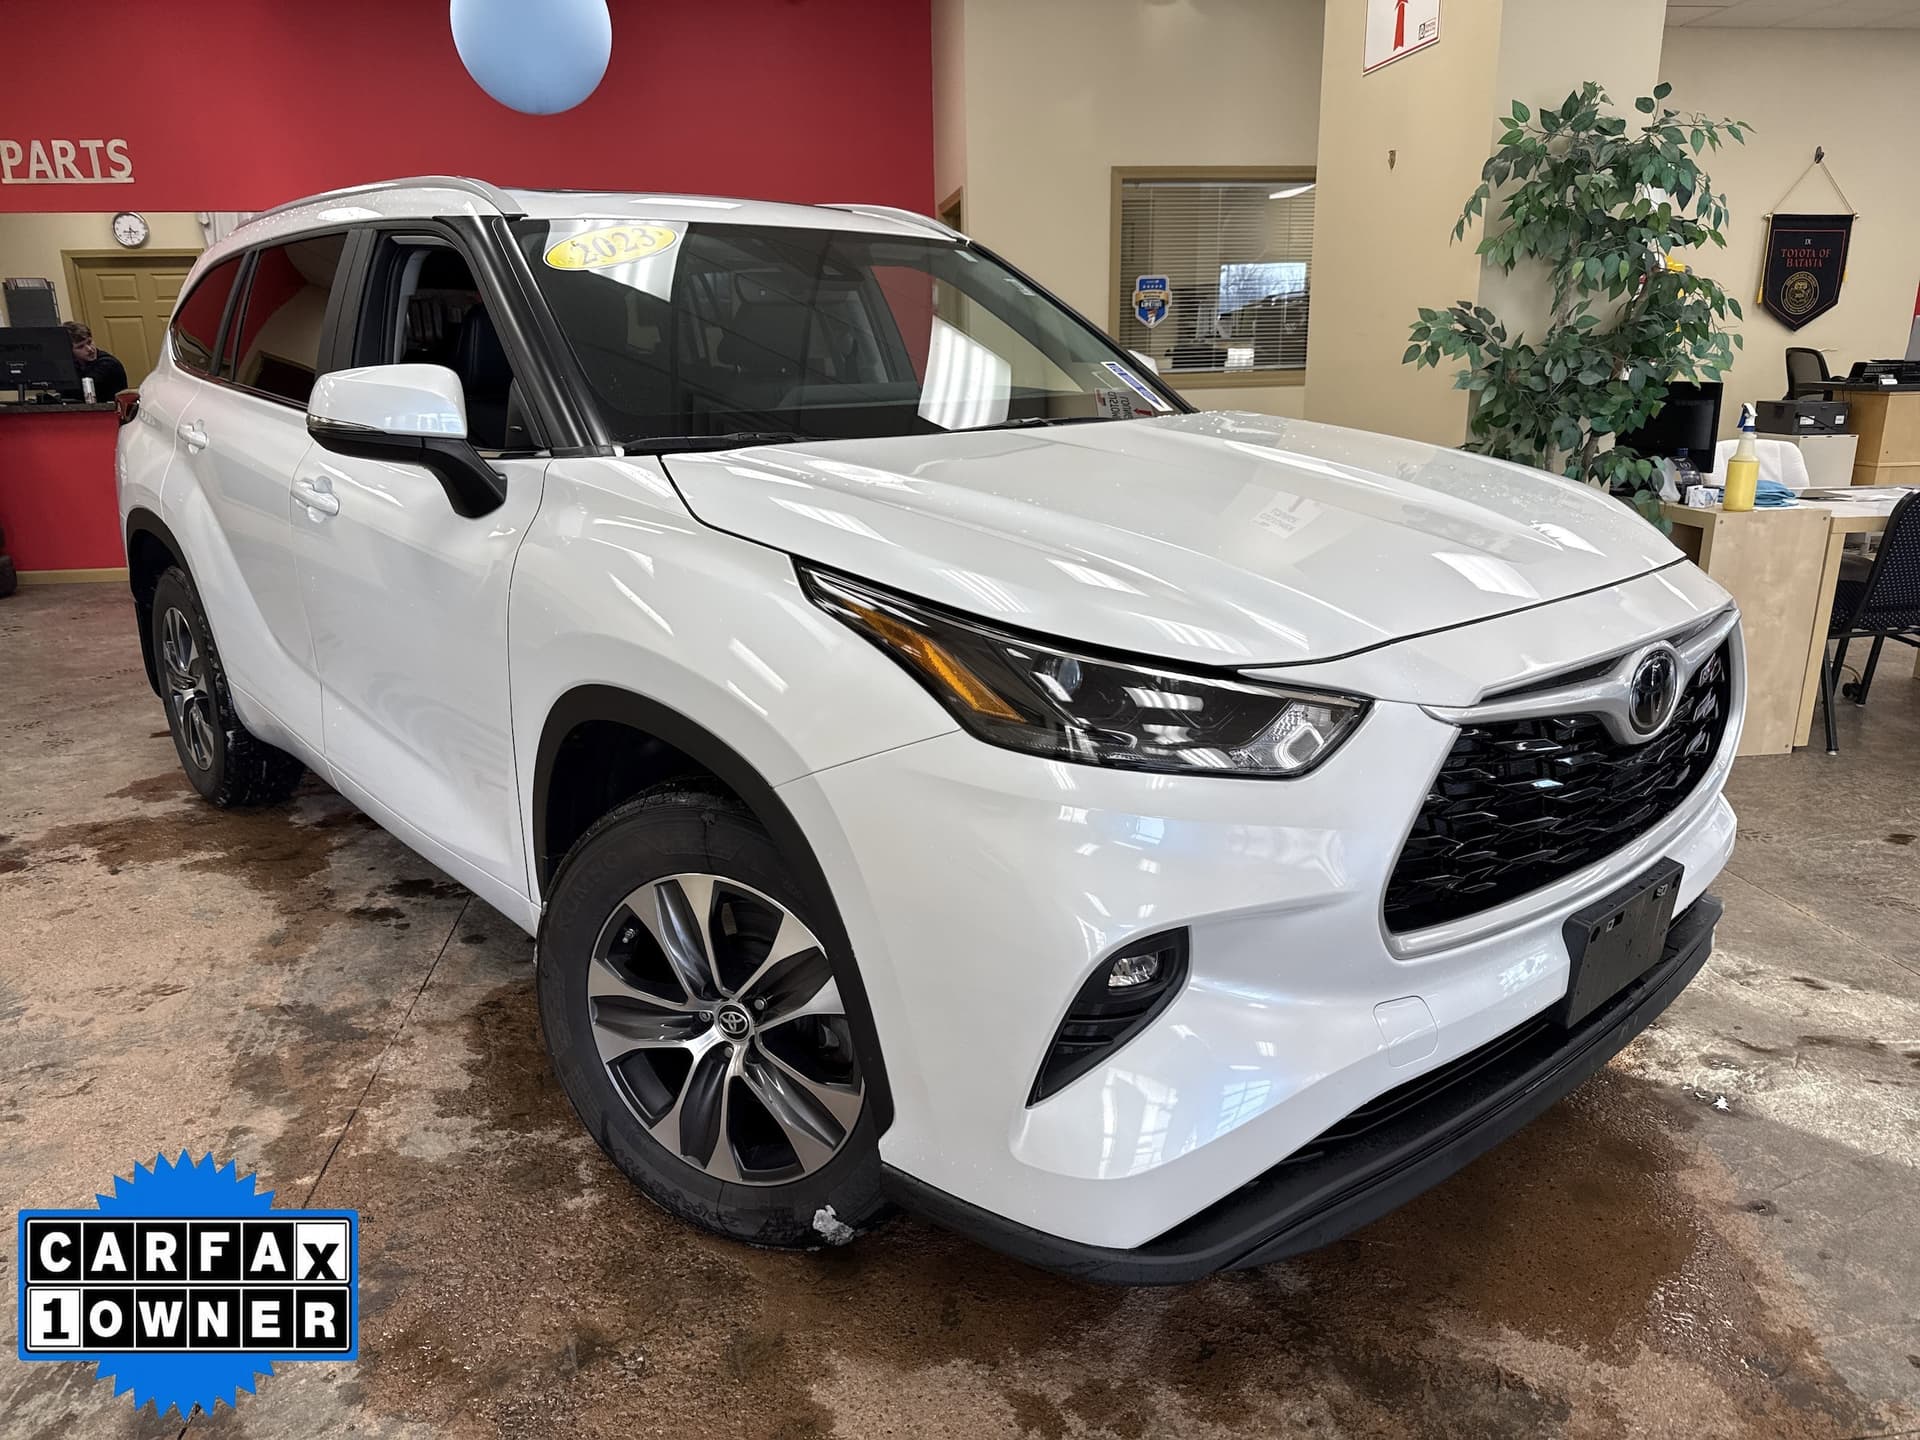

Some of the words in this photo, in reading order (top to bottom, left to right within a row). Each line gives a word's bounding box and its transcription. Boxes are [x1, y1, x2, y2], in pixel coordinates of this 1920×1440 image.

[0, 138, 133, 181] PARTS
[570, 227, 656, 265] 2023
[1781, 248, 1816, 258] TOYOTA
[1819, 248, 1832, 258] OF
[1786, 258, 1823, 268] BATAVIA
